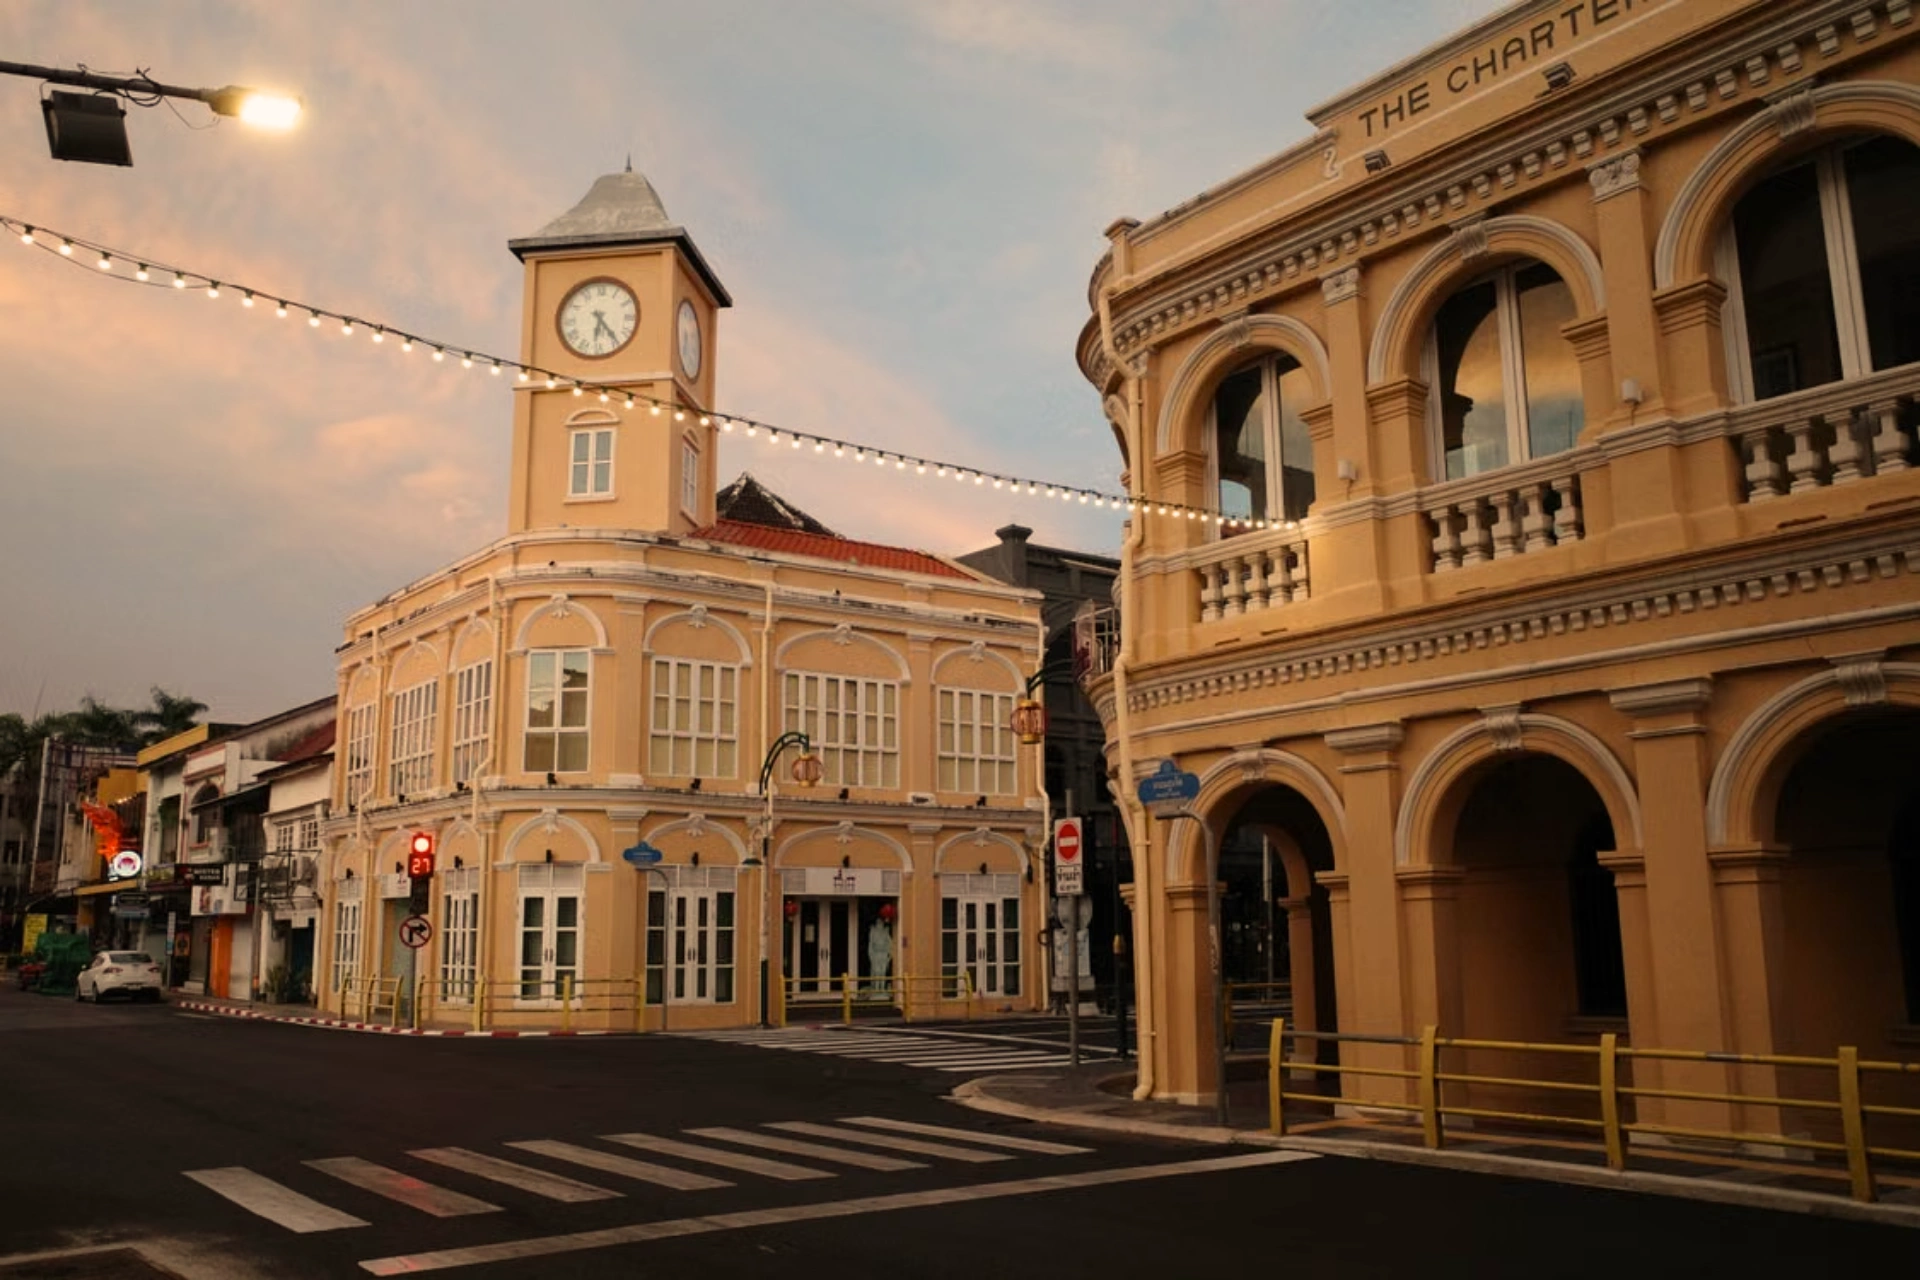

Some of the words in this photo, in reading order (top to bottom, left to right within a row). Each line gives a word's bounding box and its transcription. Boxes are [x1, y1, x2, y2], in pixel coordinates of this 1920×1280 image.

[1358, 81, 1431, 137] THE
[1446, 0, 1648, 93] CHARTE
[412, 858, 430, 874] 27
